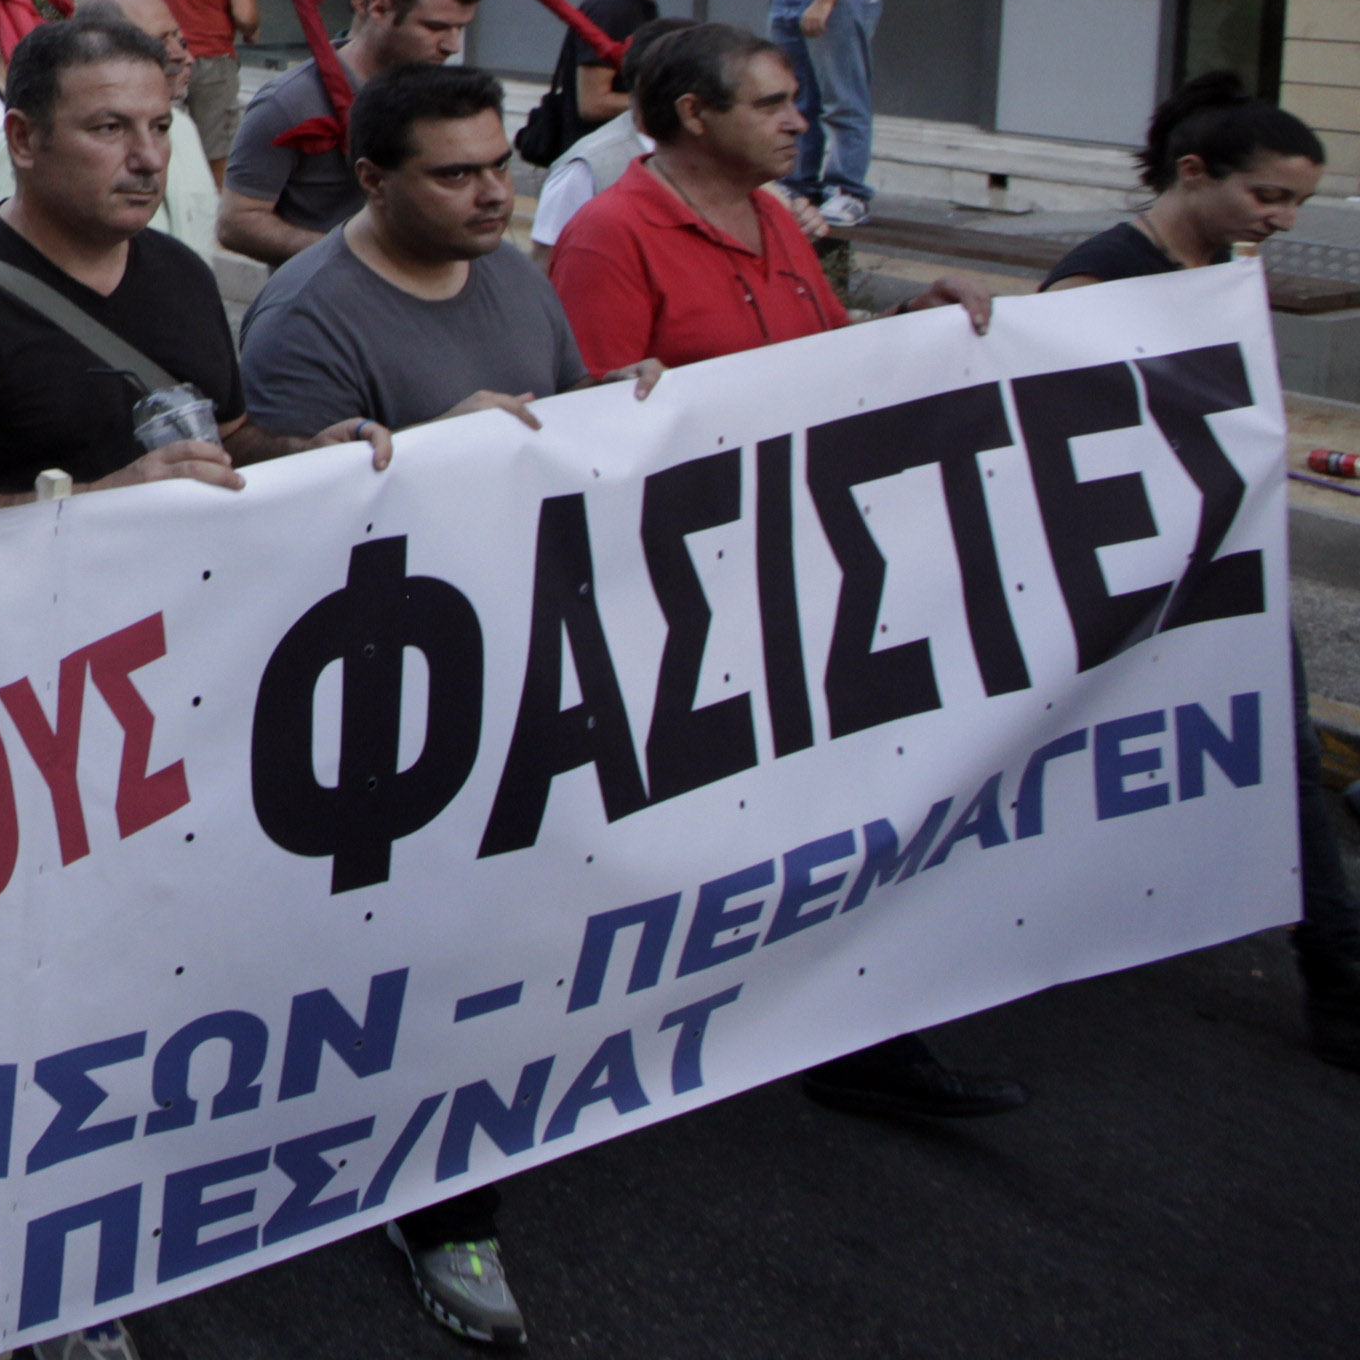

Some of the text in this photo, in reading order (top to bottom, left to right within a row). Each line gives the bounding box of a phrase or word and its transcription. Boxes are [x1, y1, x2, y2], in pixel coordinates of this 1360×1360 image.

[250, 341, 1267, 896] ΦΑΣΙΣΤΕΣ
[566, 690, 1262, 1014] ΠΕΕΜΑΓΕΝ
[17, 982, 744, 1333] ΠΕΣ/ΝΑΤ
